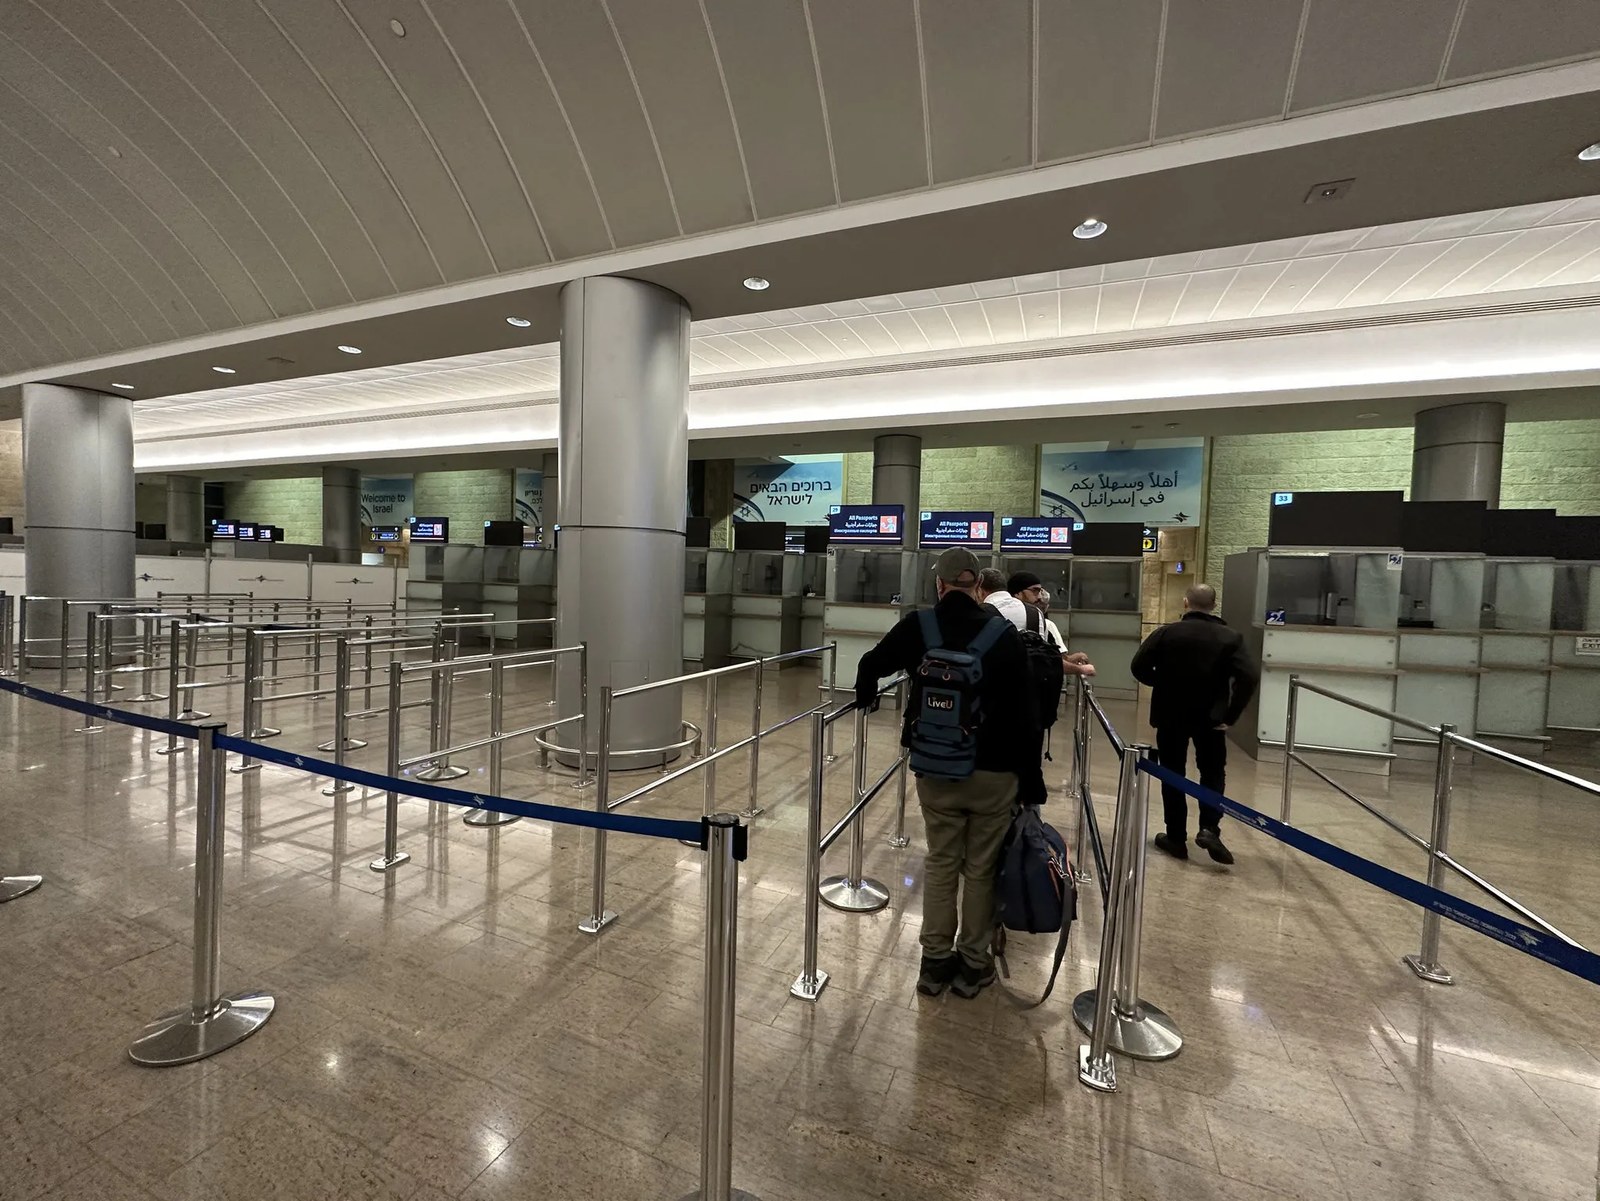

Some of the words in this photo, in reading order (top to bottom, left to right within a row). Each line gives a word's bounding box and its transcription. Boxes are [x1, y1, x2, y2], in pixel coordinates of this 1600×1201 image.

[1069, 476, 1095, 493] بكم
[1099, 473, 1144, 492] وسهلاً
[1149, 470, 1178, 488] أهلاً
[750, 482, 787, 493] הבאים
[791, 480, 832, 492] ברוכים
[361, 493, 396, 503] Welcome
[397, 493, 406, 503] to
[766, 493, 813, 506] לישראל
[1080, 491, 1135, 508] إسرائيل
[1139, 491, 1165, 508] في
[372, 503, 393, 513] Israel
[928, 697, 953, 709] LiveU
